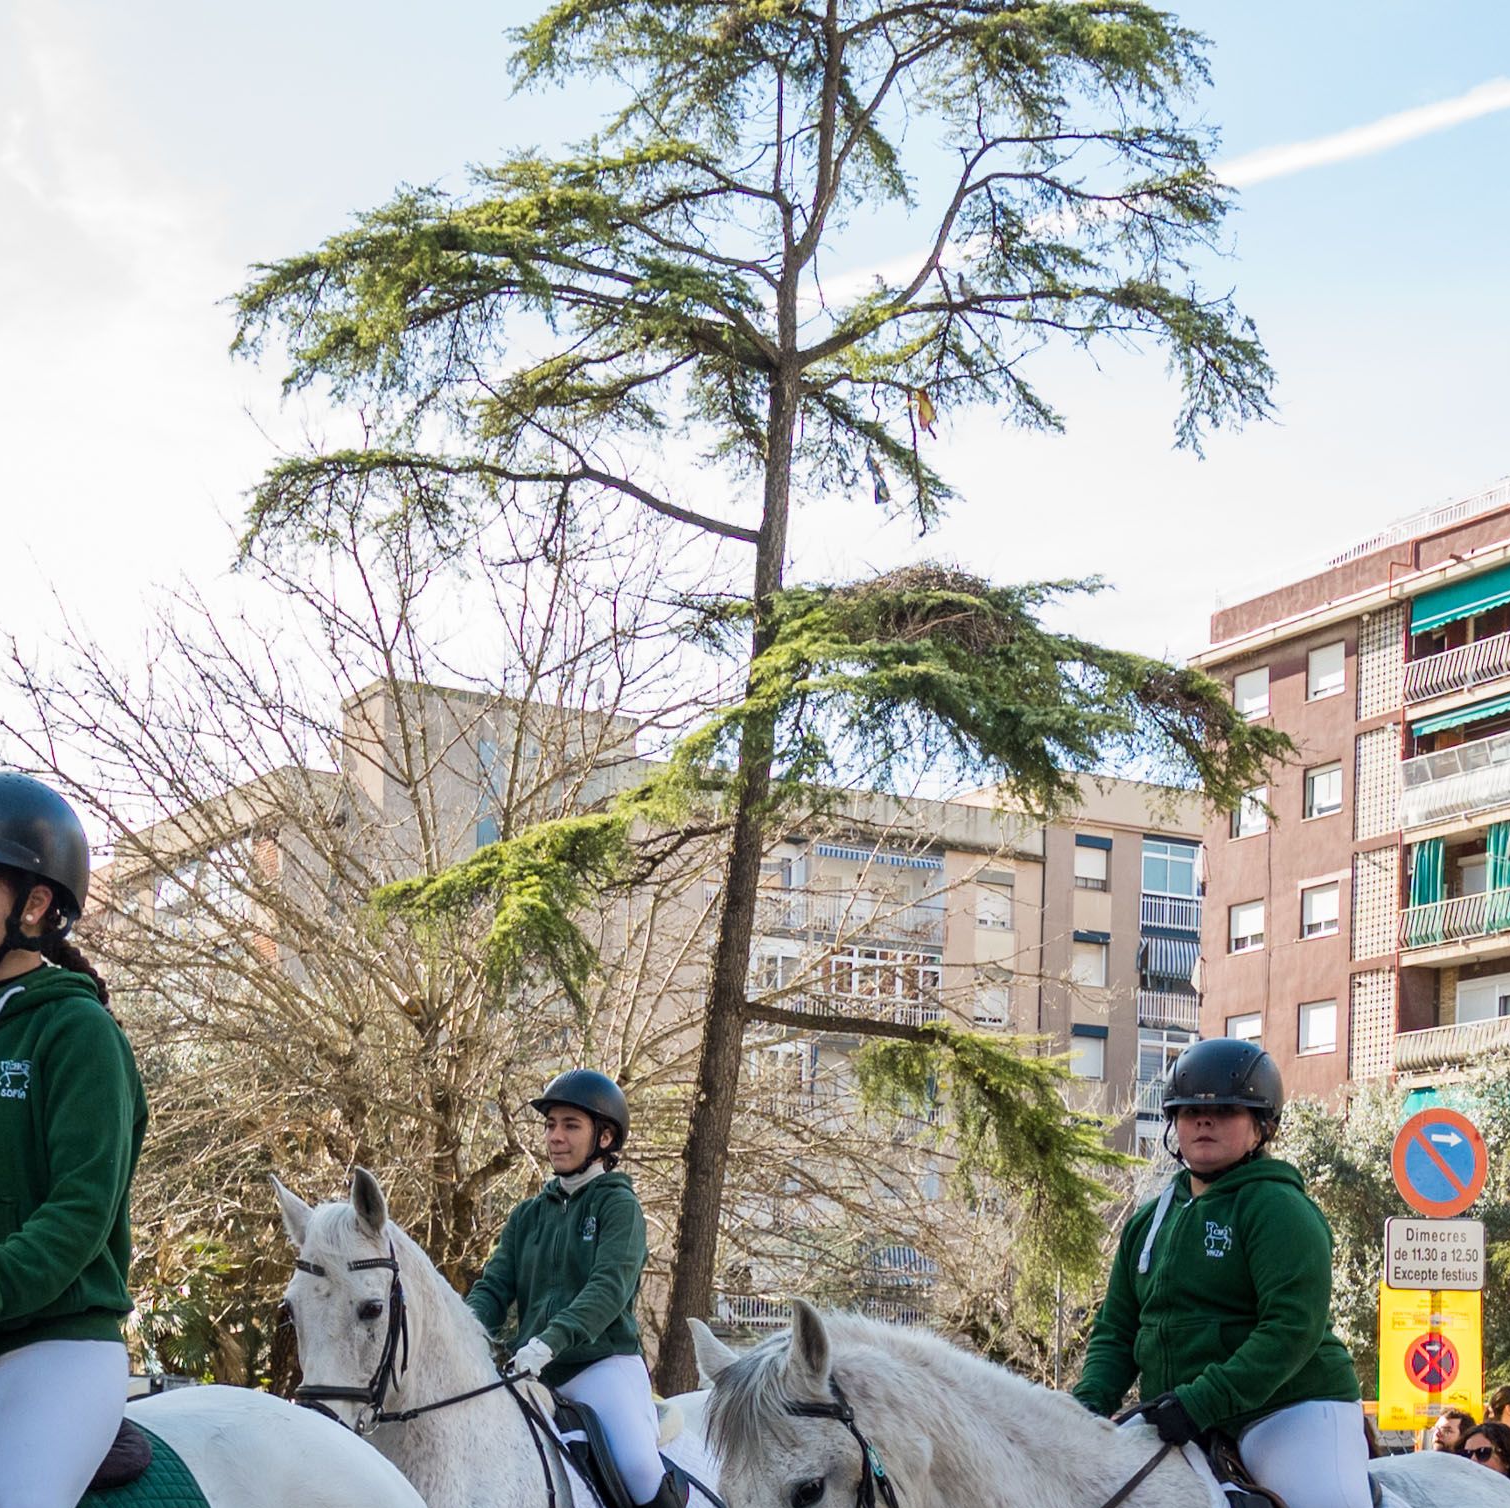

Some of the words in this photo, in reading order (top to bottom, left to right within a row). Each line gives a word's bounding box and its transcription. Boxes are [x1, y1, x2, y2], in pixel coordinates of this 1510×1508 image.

[1406, 1227, 1467, 1243] Dimecres
[1394, 1247, 1408, 1261] de
[1412, 1247, 1438, 1261] 11.30
[1440, 1250, 1447, 1262] a
[1451, 1248, 1479, 1263] 12.50
[1394, 1266, 1438, 1284] Excepte
[1441, 1267, 1478, 1282] festius
